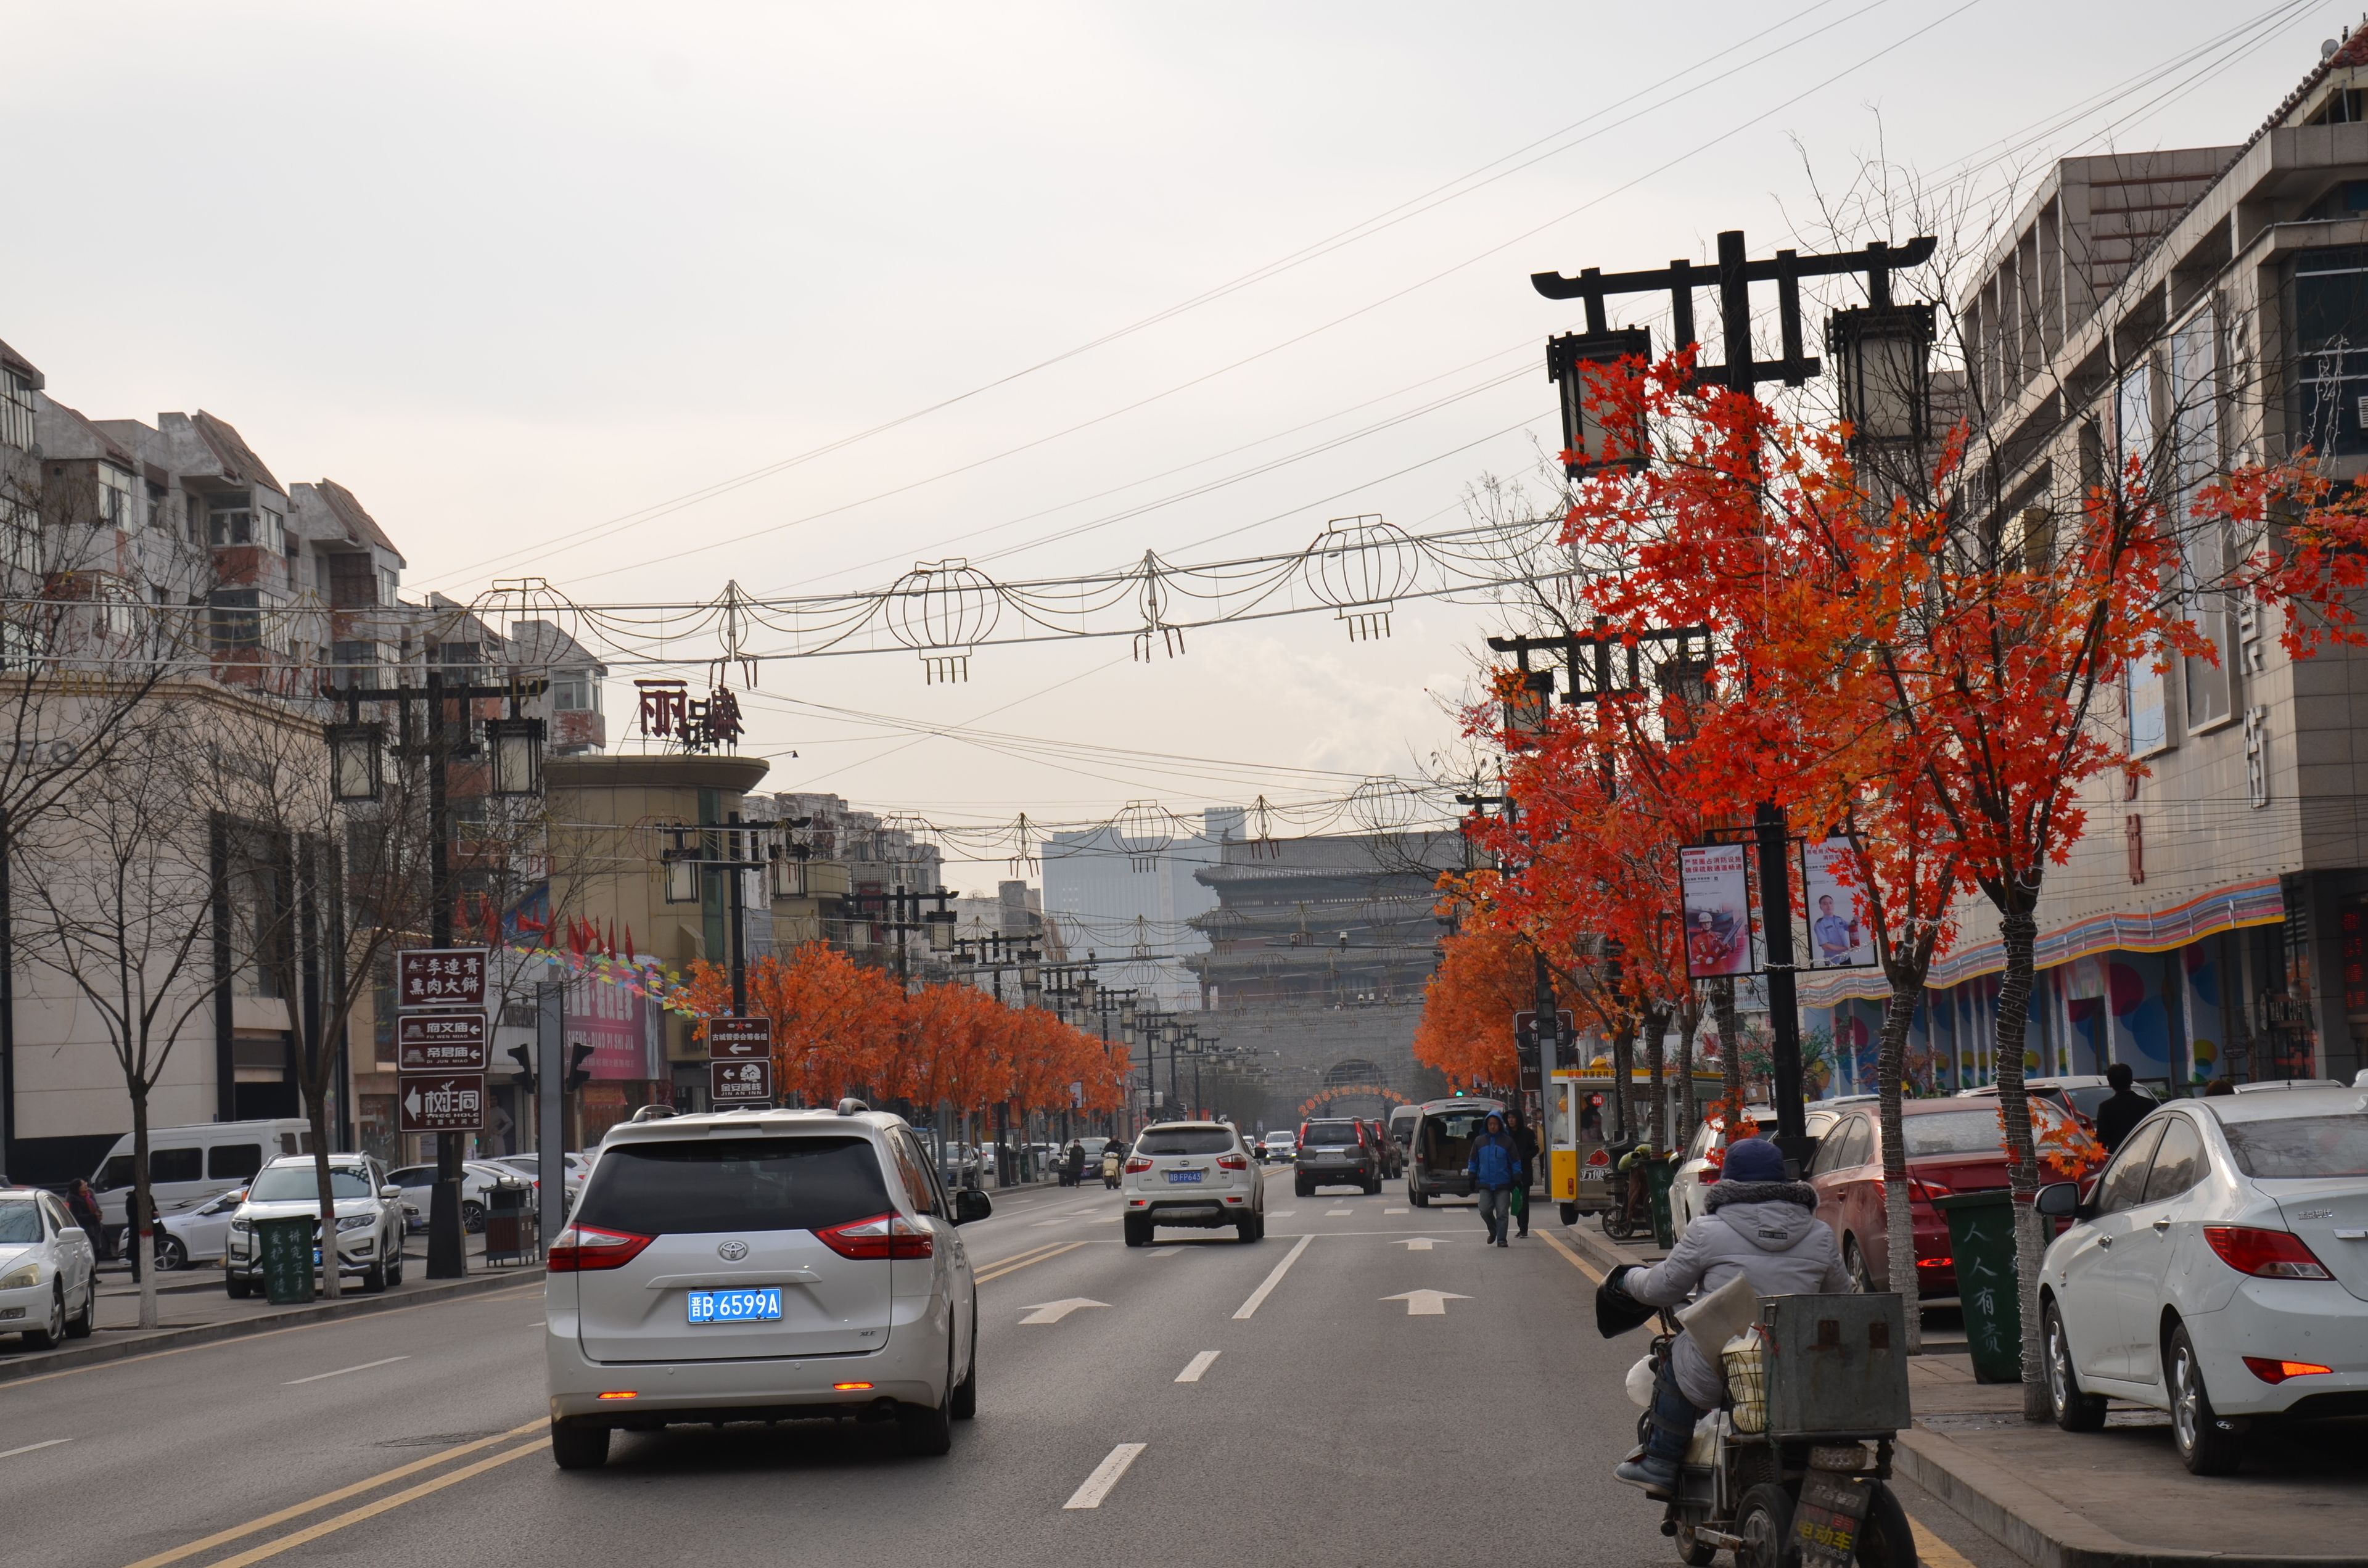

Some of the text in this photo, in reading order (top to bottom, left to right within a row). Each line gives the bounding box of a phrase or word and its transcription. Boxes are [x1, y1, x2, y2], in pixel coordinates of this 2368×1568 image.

[427, 1022, 468, 1033] 府文庙
[625, 1035, 634, 1050] JIA
[712, 1033, 768, 1041] 古城管委会筹备组
[427, 1047, 468, 1057] 帝君庙
[721, 1083, 762, 1092] 金安客栈
[1581, 1168, 1613, 1181] 方便
[2298, 1209, 2333, 1220] 北京现代
[1963, 1221, 2002, 1353] 人人有责
[1796, 1519, 1852, 1550] 电动车
